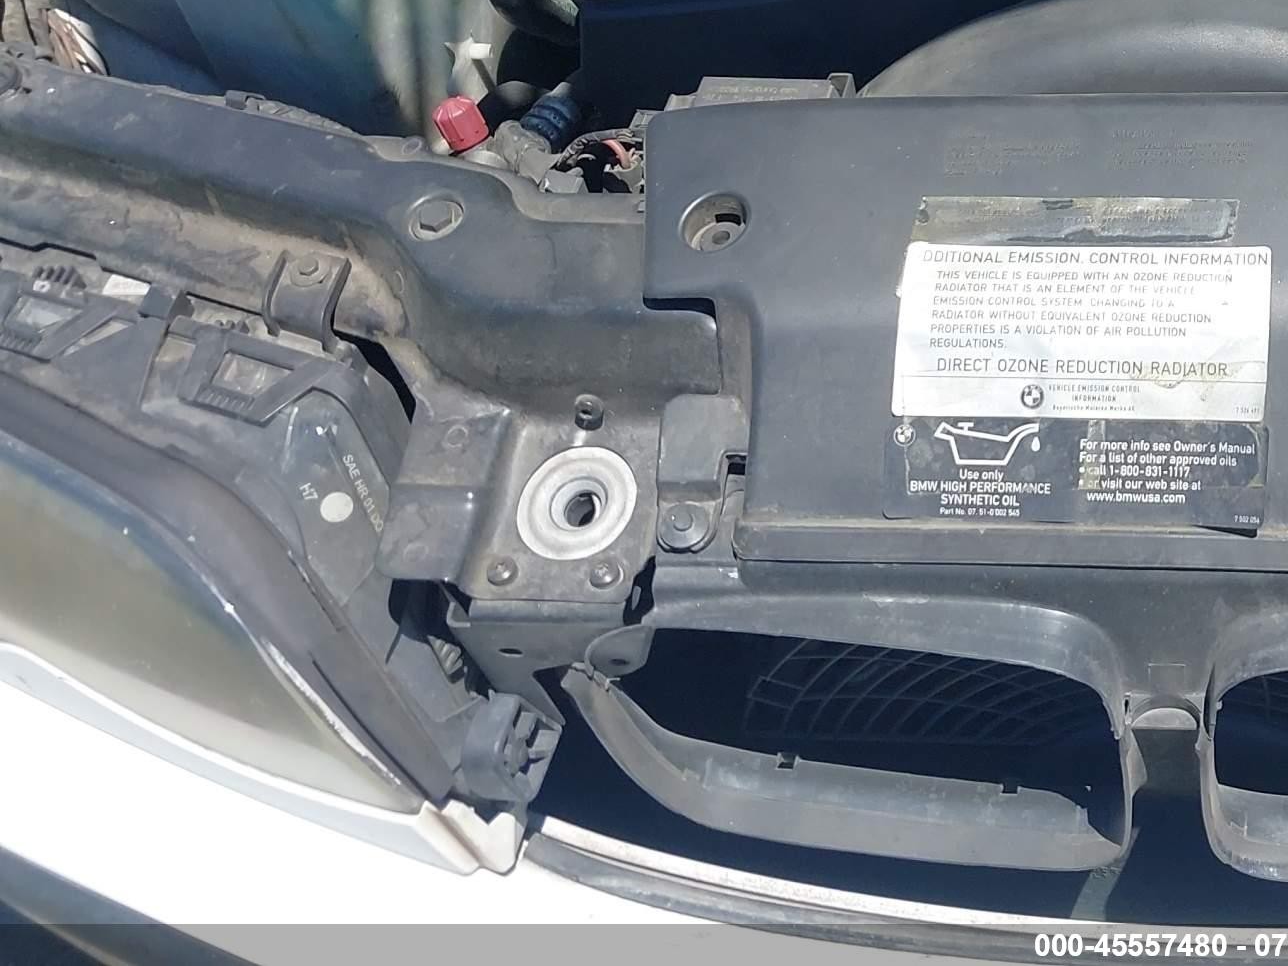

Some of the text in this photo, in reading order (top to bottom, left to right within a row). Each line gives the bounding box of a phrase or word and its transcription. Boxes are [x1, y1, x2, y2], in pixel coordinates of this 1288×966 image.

[1089, 252, 1158, 264] CONTROL
[1164, 252, 1268, 266] INFORMATION
[936, 270, 1233, 283] THIS VEHICLE IS EQUIPPED WITH AN OZONE REDUCTION
[934, 283, 1196, 295] RADIATOR THAT IS AN ELEMENT OF THE VEHICLE
[933, 296, 983, 306] EMISSION
[988, 296, 1036, 306] CONTROL
[1041, 297, 1082, 306] SYSTEM
[1090, 298, 1146, 308] CHANGING
[1168, 299, 1175, 308] A
[932, 310, 1212, 323] RADIATOR WITHOUT EQUIVALENT OZONE REDUCTION
[930, 324, 1187, 337] PROPERTIES IS A VIOLATION OF AIR POLLUTION
[937, 358, 1229, 376] DIRECT OZONE REDUCTION RADIATOR
[1079, 439, 1097, 450] For
[1100, 440, 1128, 451] more
[1130, 439, 1150, 451] info
[1152, 442, 1171, 451] see
[1218, 442, 1255, 454] Manual
[1079, 451, 1237, 467] For a list of other approved oils
[959, 468, 1004, 482] Use only
[1087, 465, 1190, 477] call 1-800-831-1117
[343, 454, 361, 479] SAE
[354, 479, 369, 499] HR
[363, 497, 375, 513] 01
[910, 481, 1051, 494] BMW HIGH PERFORMANCE
[1087, 478, 1201, 490] or visit our web site at
[299, 482, 319, 501] H7
[1086, 491, 1186, 504] www.bmwusa.com
[940, 493, 1020, 506] SYNTHETIC OIL
[940, 507, 954, 515] Part
